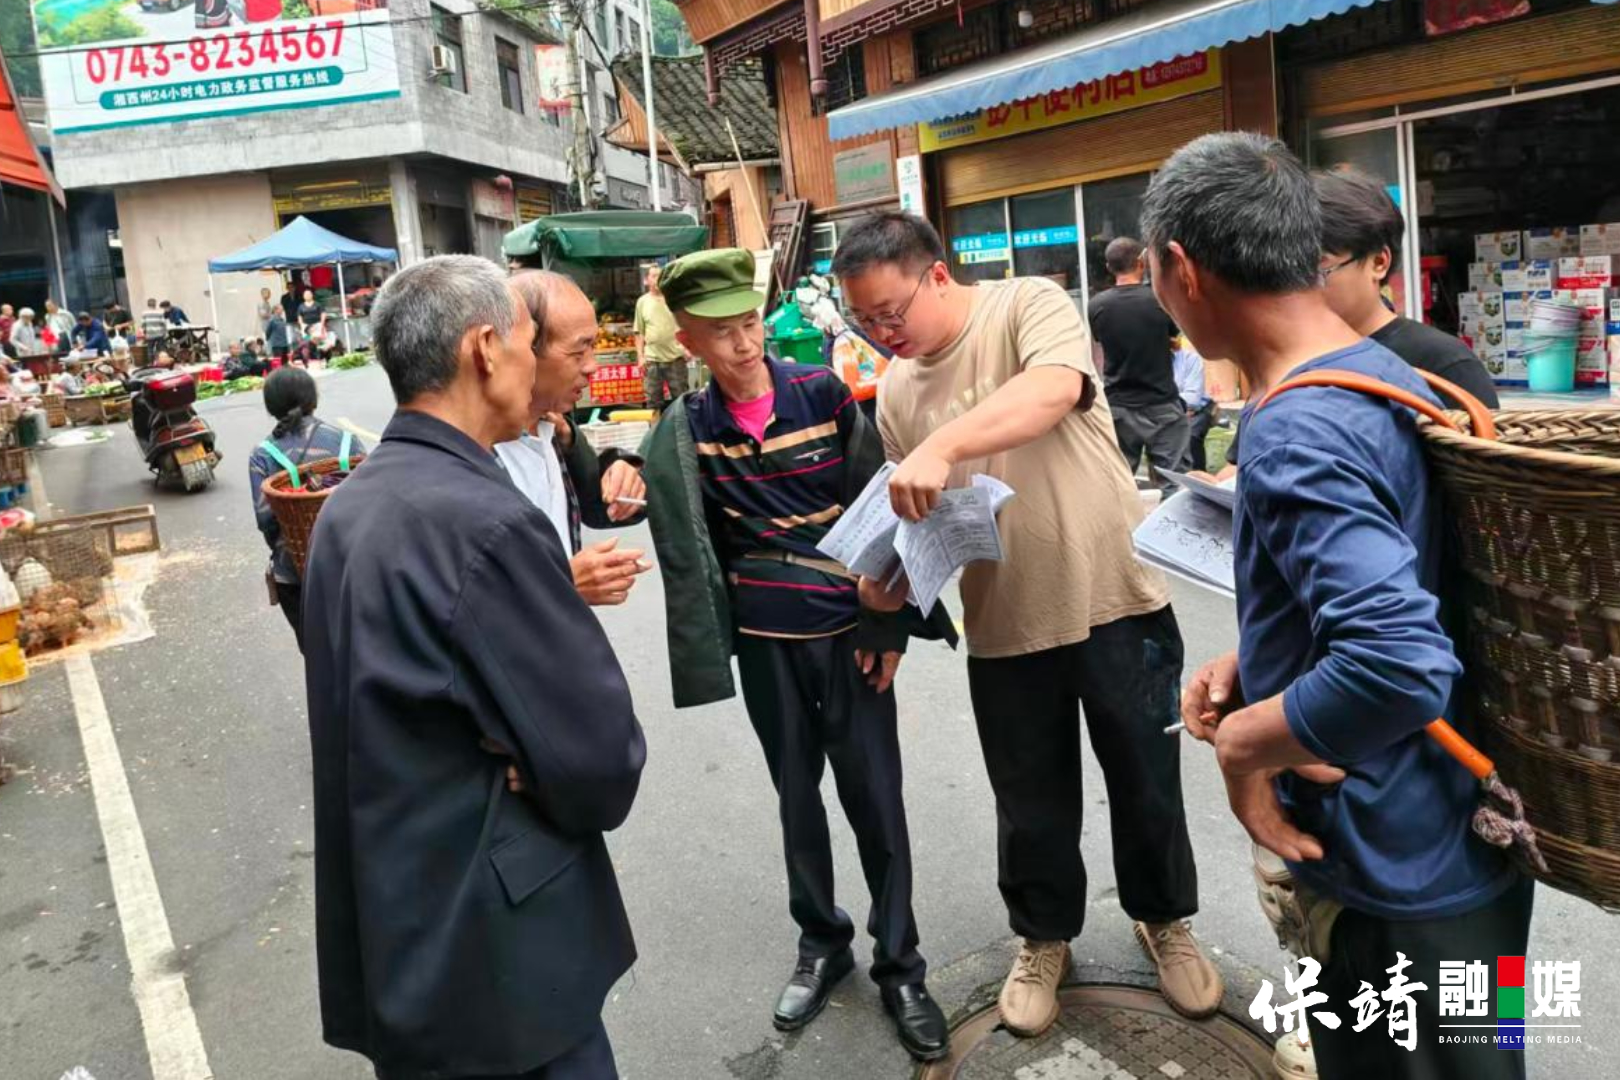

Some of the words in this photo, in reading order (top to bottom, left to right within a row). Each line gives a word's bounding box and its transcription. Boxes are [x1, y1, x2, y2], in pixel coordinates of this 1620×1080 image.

[86, 20, 344, 84] 0743-8234567
[113, 69, 330, 107] 湘西州24小时电力政务监督服务热线
